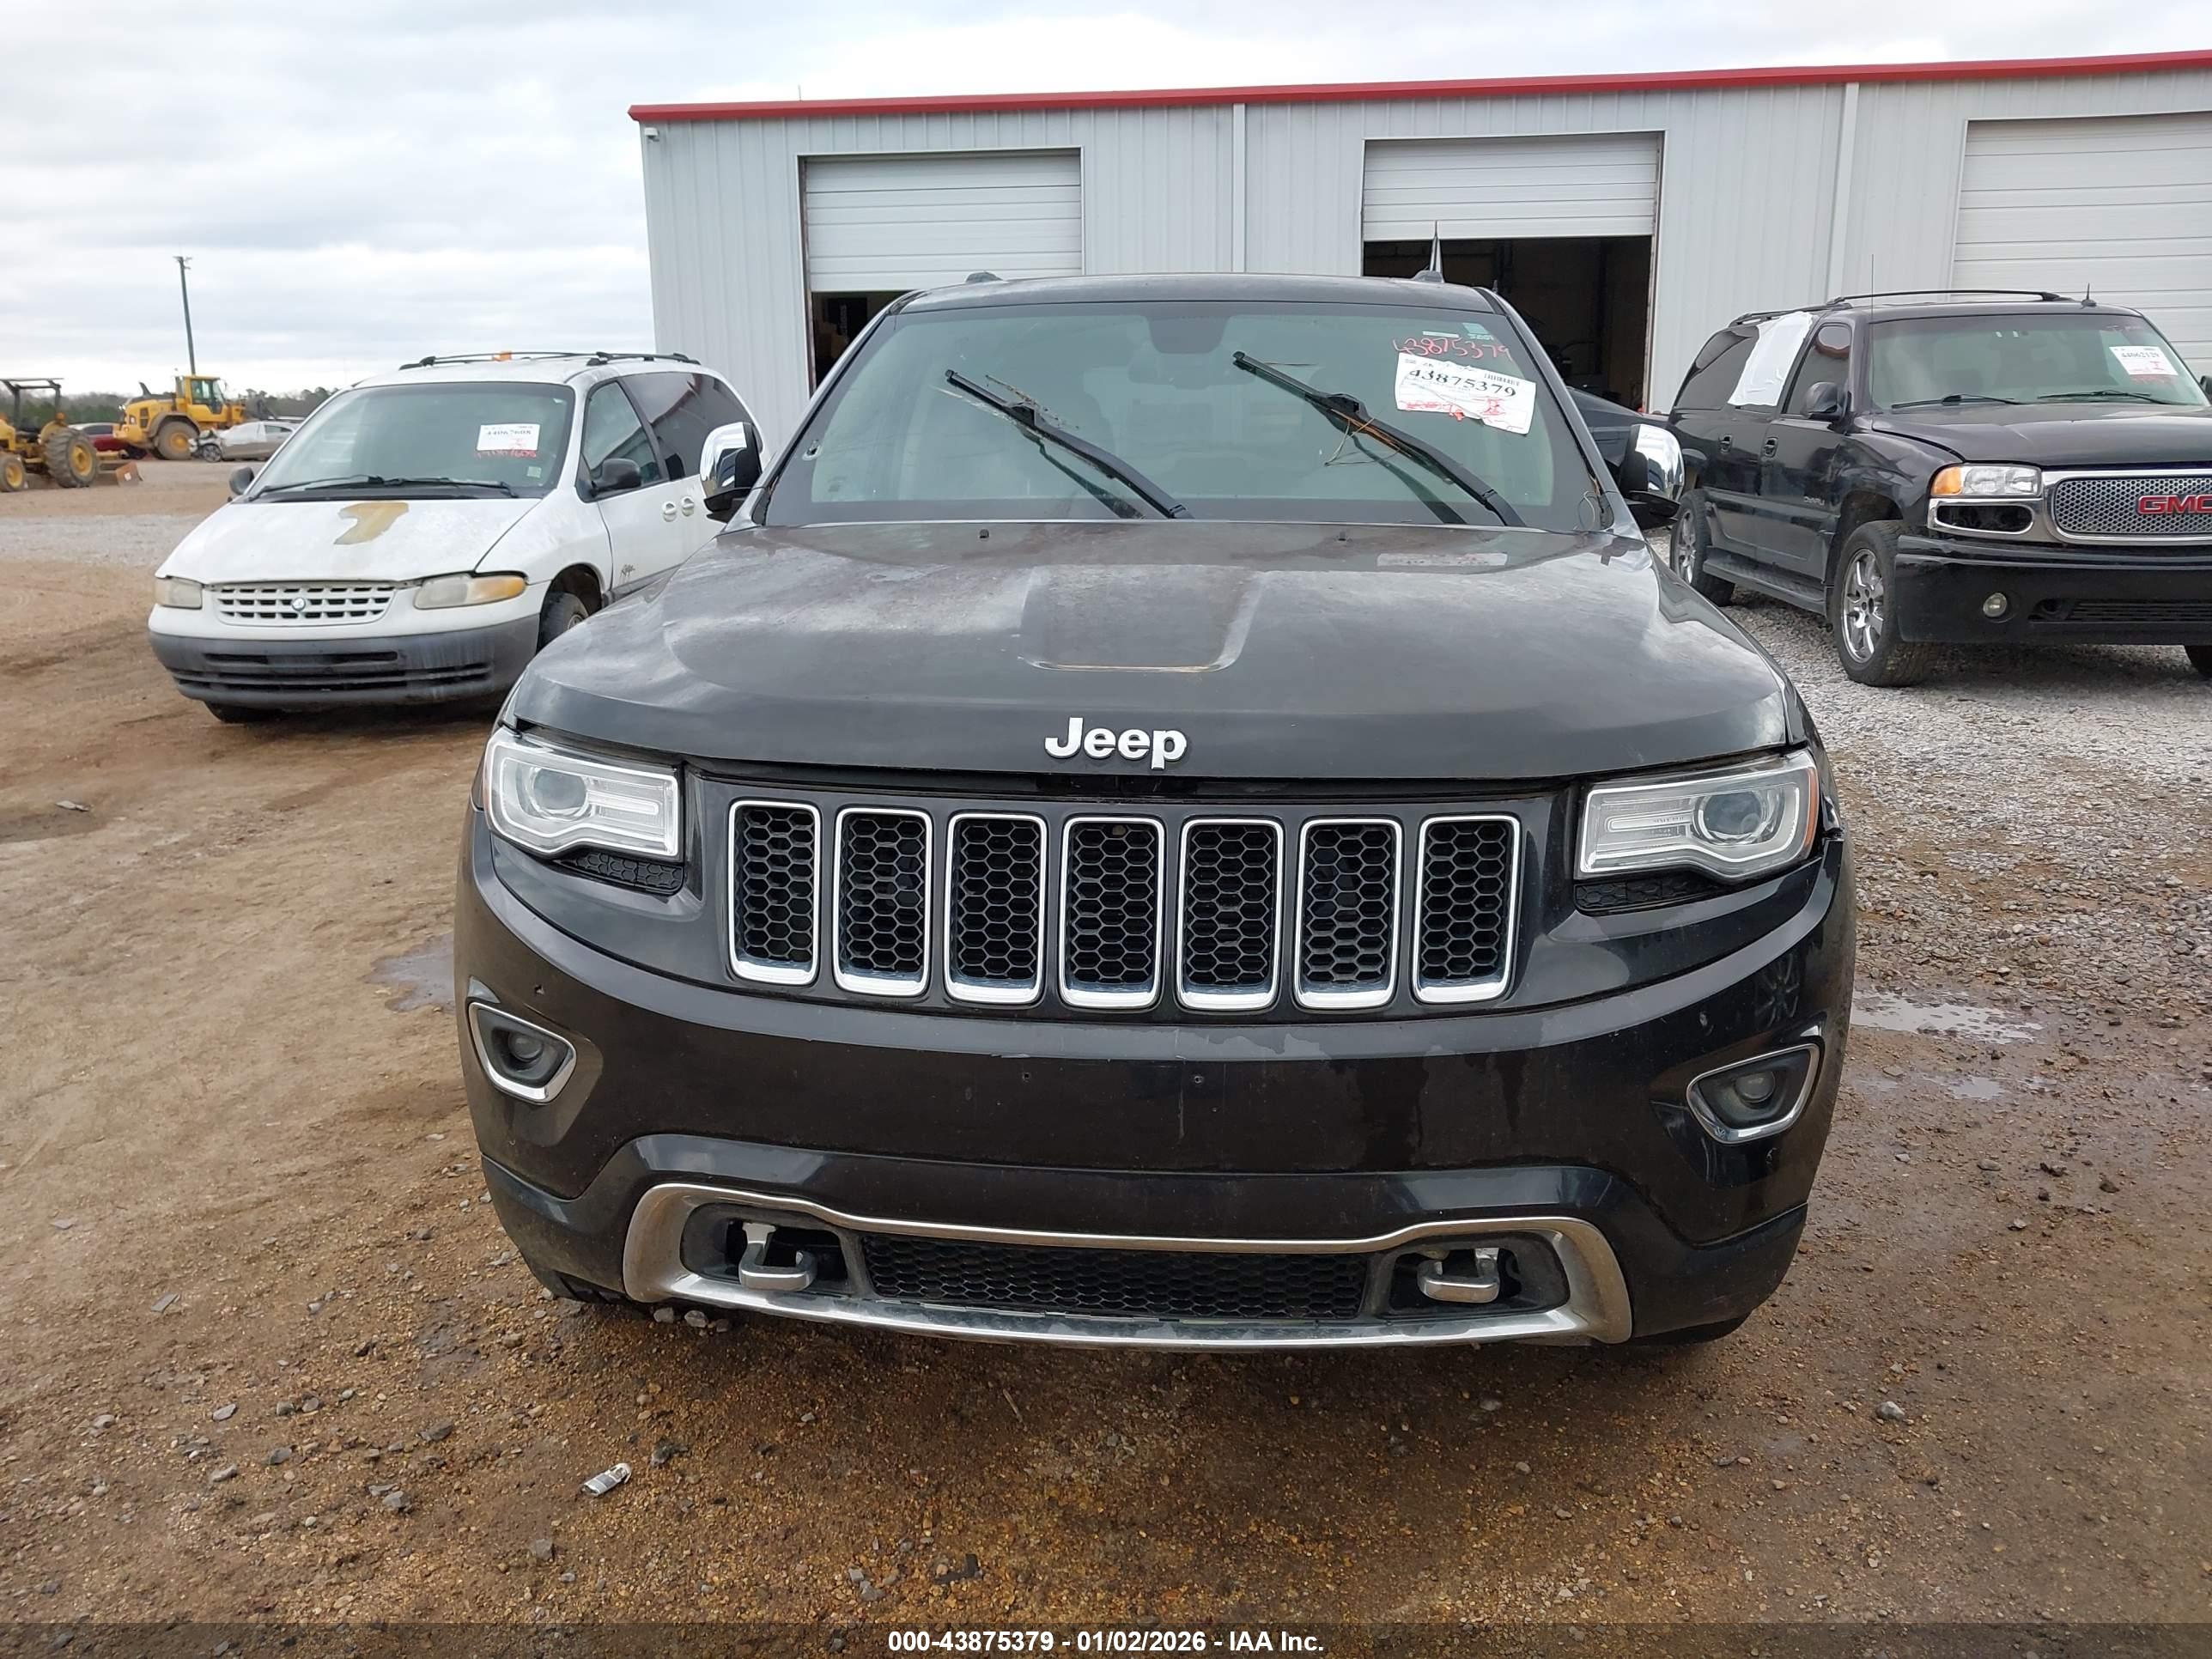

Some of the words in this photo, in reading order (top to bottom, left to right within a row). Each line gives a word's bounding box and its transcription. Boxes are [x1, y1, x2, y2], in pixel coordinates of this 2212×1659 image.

[1393, 337, 1515, 362] 43875379
[1409, 368, 1516, 398] 43875379
[2138, 495, 2212, 514] GMC
[1044, 717, 1188, 770] Jeep
